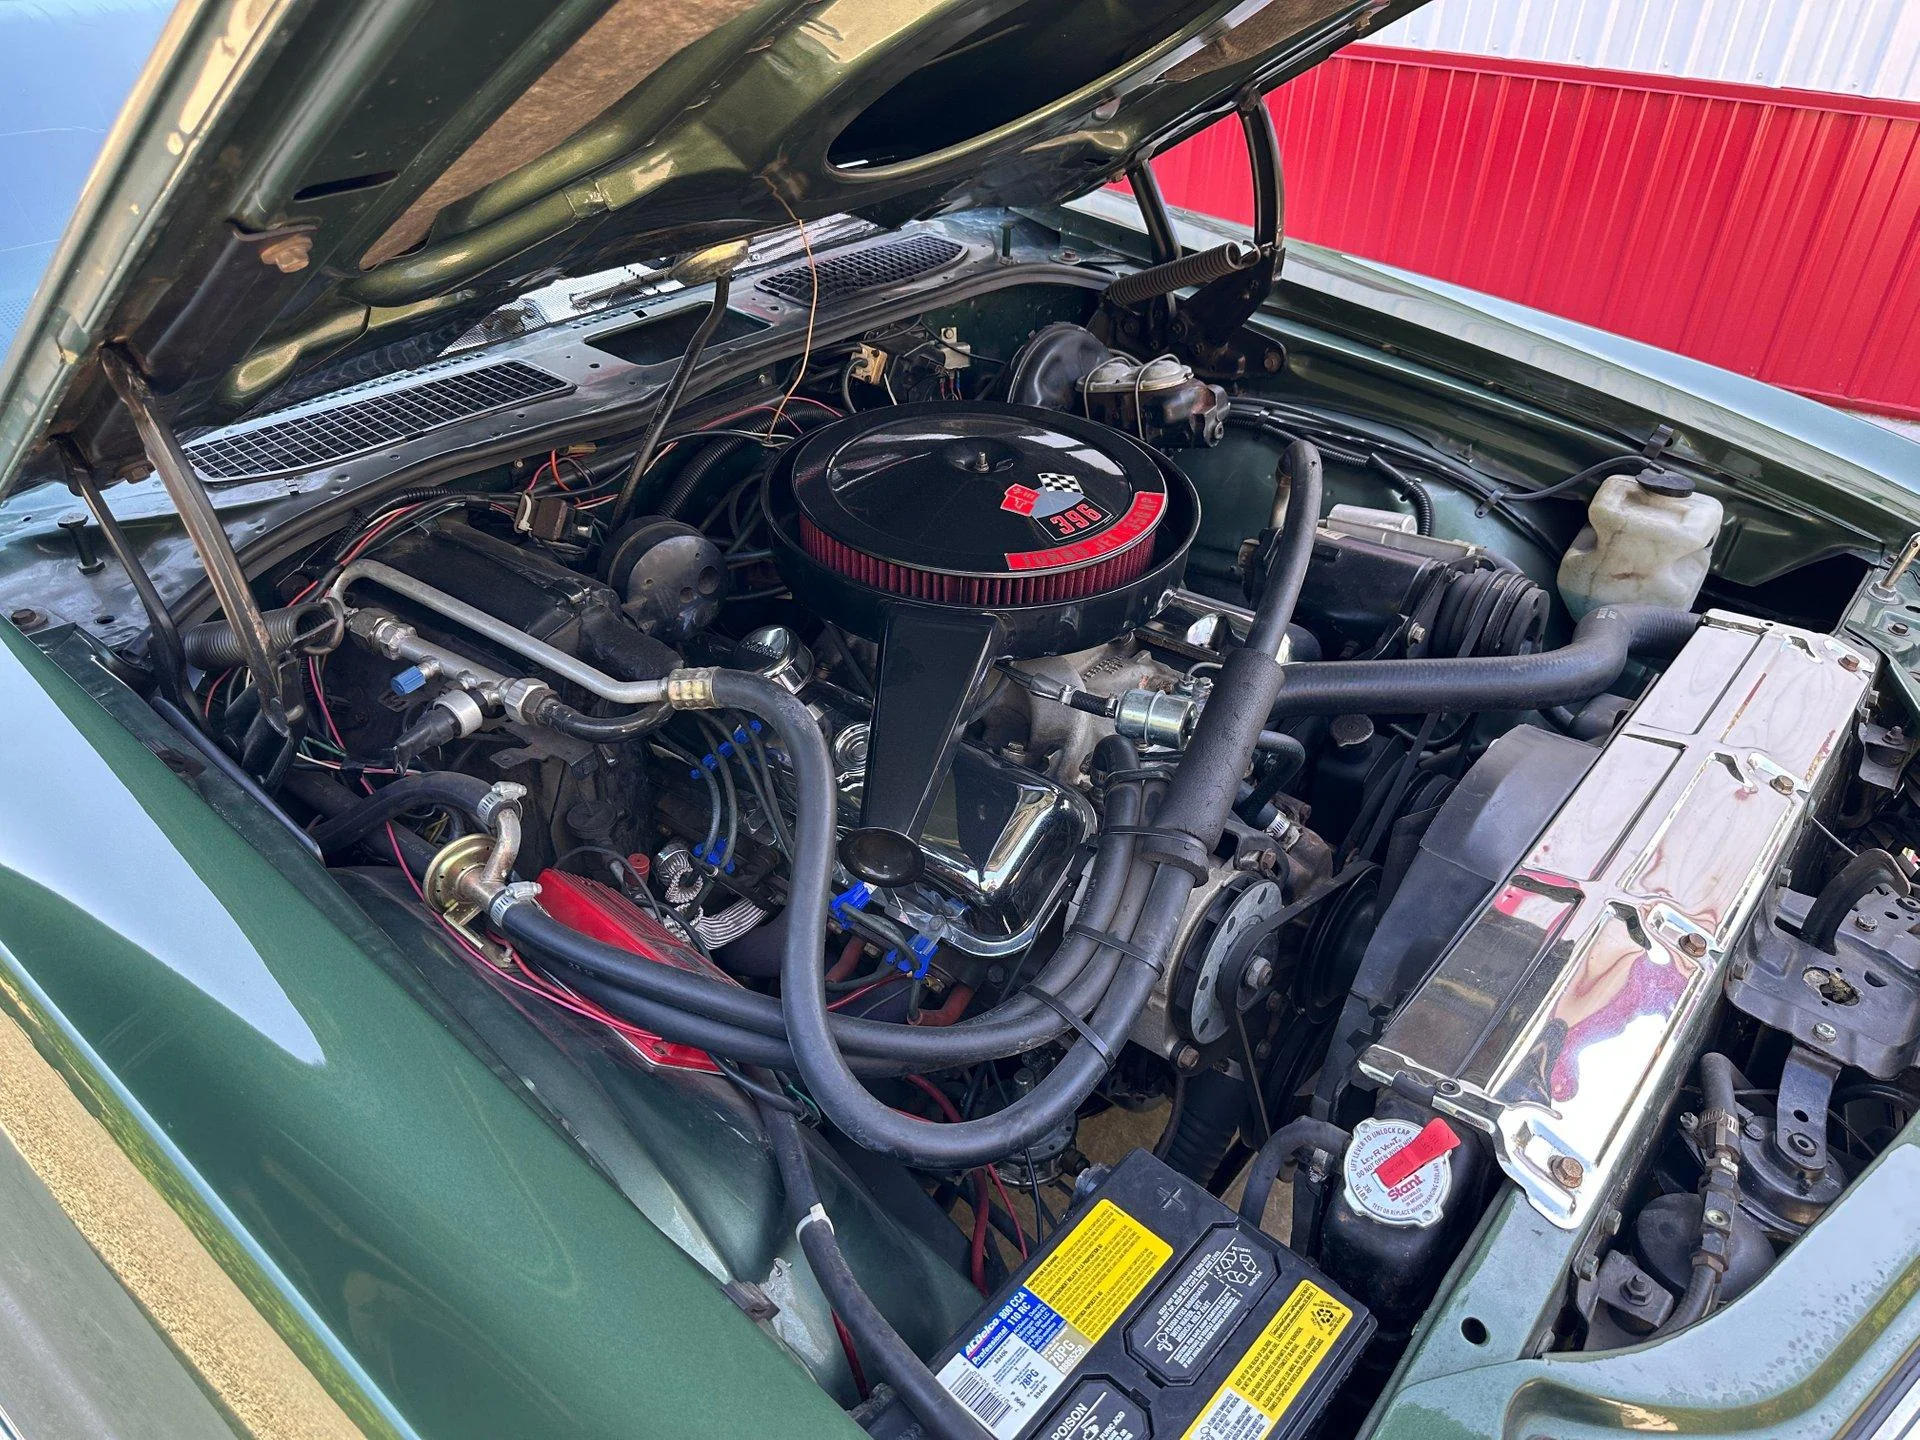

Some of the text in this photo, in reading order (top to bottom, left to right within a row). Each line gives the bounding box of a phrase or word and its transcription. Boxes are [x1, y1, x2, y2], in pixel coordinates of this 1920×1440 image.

[1050, 503, 1102, 535] 396
[1354, 1142, 1366, 1158] LEVER
[1372, 1127, 1395, 1137] UNLOCK
[1397, 1128, 1410, 1136] CAP
[1356, 1170, 1365, 1178] DO
[1366, 1163, 1377, 1173] NOT
[1375, 1156, 1387, 1165] OPEN
[1403, 1137, 1412, 1147] HOT
[1354, 1184, 1368, 1201] 16 LBS
[1372, 1203, 1382, 1211] TEST
[1411, 1203, 1423, 1213] WHEN
[1422, 1184, 1438, 1205] CHANGING
[1387, 1175, 1423, 1202] Stant
[998, 1290, 1027, 1319] 800 CCA
[1006, 1301, 1031, 1326] 110 RC
[1163, 1280, 1209, 1334] FLUSH EYES IMMEDIATELY
[1169, 1323, 1183, 1338] WITH
[1192, 1299, 1203, 1310] GET
[962, 1316, 1000, 1355] ACDelco
[1175, 1299, 1211, 1342] MEDICAL HELP FAST
[970, 1325, 1009, 1364] Professional
[1046, 1337, 1076, 1368] 78PG
[1019, 1368, 1039, 1389] 78PG
[1050, 1401, 1088, 1440] POISON
[1111, 1410, 1126, 1425] ACID
